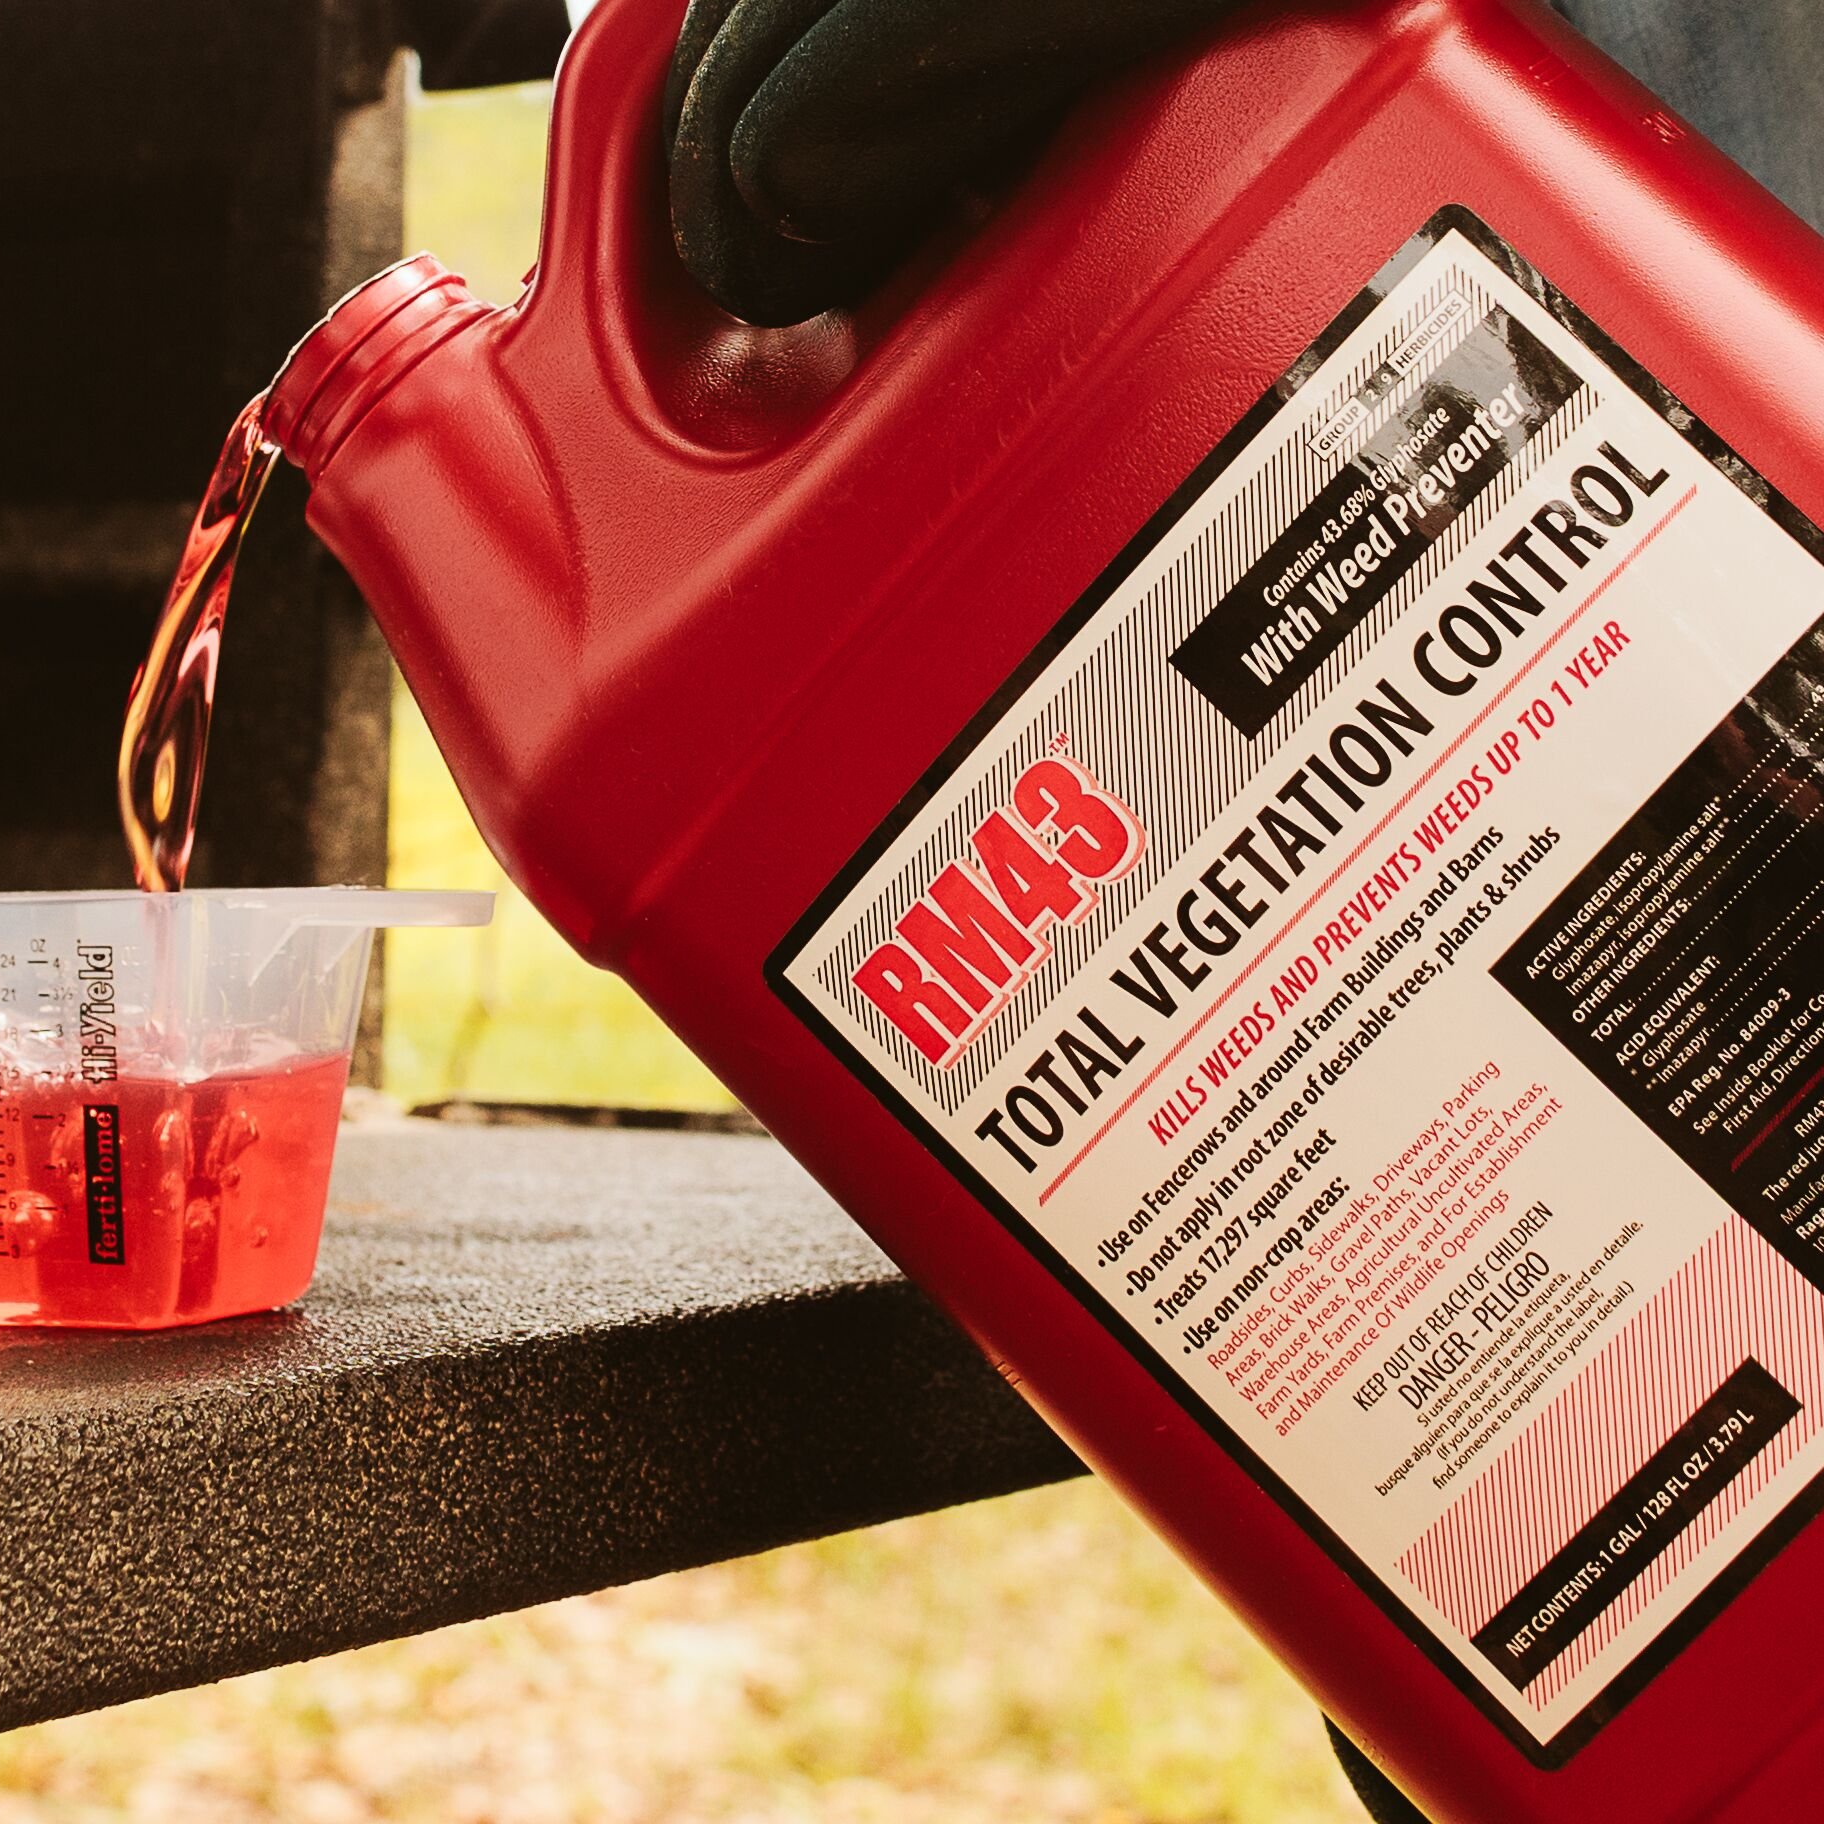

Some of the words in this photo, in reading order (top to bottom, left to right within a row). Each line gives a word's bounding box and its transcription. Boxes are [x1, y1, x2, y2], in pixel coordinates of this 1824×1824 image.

[1318, 405, 1358, 451] GROUP
[1394, 301, 1462, 369] HERBICIDES
[1239, 603, 1322, 686] With
[1304, 512, 1397, 616] Weed
[1382, 379, 1523, 537] Preventer
[1262, 538, 1326, 607] Contains
[1320, 482, 1376, 544] 43.68%
[1365, 406, 1451, 493] Glyphosate
[973, 1004, 1146, 1174] TOTAL
[1107, 676, 1435, 1019] VEGETATION
[1412, 439, 1670, 697] CONTROL
[1146, 1074, 1208, 1147] KILLS
[1197, 999, 1276, 1088] WEEDS
[1269, 954, 1319, 1017] AND
[1311, 841, 1422, 966] PREVENTS
[1411, 763, 1494, 854] WEEDS
[1484, 729, 1521, 775] UP
[1516, 698, 1555, 741] TO
[1549, 679, 1573, 706] 1
[1563, 619, 1631, 689] YEAR
[0, 957, 16, 968] 24
[1, 988, 16, 1001] 21
[30, 939, 46, 951] OZ
[1525, 930, 1570, 979] ACTIVE
[1562, 850, 1647, 937] INGREDIENTS:
[1614, 1031, 1647, 1066] ACID
[1641, 954, 1721, 1036] EQUIVALENT:
[5, 1109, 19, 1122] 12
[1096, 1229, 1134, 1263] Use
[1126, 1207, 1154, 1235] on
[1140, 1125, 1227, 1216] Fencerows
[1219, 1087, 1258, 1133] and
[1249, 1027, 1313, 1100] around
[1300, 990, 1353, 1041] Farm
[1340, 910, 1425, 997] Buildings
[1418, 870, 1458, 917] and
[1445, 825, 1504, 882] Barns
[1125, 1264, 1156, 1293] Do
[1148, 1234, 1183, 1272] not
[1173, 1191, 1223, 1244] apply
[1209, 1175, 1239, 1200] in
[1230, 1137, 1272, 1183] root
[1262, 1099, 1308, 1148] zone
[1301, 1072, 1325, 1105] of
[1317, 1004, 1397, 1086] desirable
[1386, 958, 1444, 1009] trees,
[1434, 899, 1492, 966] plants
[1481, 882, 1508, 906] &
[1500, 825, 1561, 891] shrubs
[1666, 1088, 1697, 1117] EPA
[1690, 1064, 1723, 1093] Reg.
[1716, 1042, 1744, 1065] No.
[1738, 986, 1791, 1042] 84009-3
[1691, 1109, 1719, 1135] See
[1712, 1073, 1752, 1113] Inside
[1746, 1027, 1796, 1077] Booklet
[1789, 1008, 1812, 1031] for
[1152, 1267, 1208, 1321] Treats
[1197, 1214, 1250, 1274] 17,297
[1245, 1165, 1304, 1228] square
[1292, 1127, 1337, 1172] feet
[1181, 1316, 1220, 1350] Use
[1213, 1294, 1240, 1323] on
[1230, 1225, 1305, 1303] non-crop
[1296, 1175, 1350, 1232] areas:
[1205, 1303, 1276, 1371] Roadsides,
[1268, 1261, 1315, 1303] Curbs,
[1306, 1192, 1381, 1263] Sidewalks,
[1371, 1118, 1449, 1192] Driveways,
[1441, 1060, 1501, 1118] Parking
[1224, 1347, 1267, 1388] Areas,
[1257, 1312, 1296, 1349] Brick
[1286, 1273, 1336, 1316] Walks,
[1329, 1222, 1376, 1273] Gravel
[1368, 1187, 1416, 1231] Paths,
[1407, 1136, 1461, 1186] Vacant
[1452, 1105, 1494, 1140] Lots,
[1237, 1330, 1311, 1402] Warehouse
[1305, 1292, 1351, 1335] Areas,
[1344, 1207, 1422, 1294] Agricultural
[1415, 1119, 1505, 1214] Uncultivated
[1500, 1082, 1548, 1127] Areas,
[1254, 1384, 1293, 1421] Farm
[1284, 1349, 1330, 1387] Yards,
[1320, 1312, 1361, 1350] Farm
[1353, 1251, 1422, 1316] Premises,
[1416, 1216, 1446, 1253] and
[1439, 1194, 1468, 1224] For
[1462, 1097, 1563, 1199] Establishment
[1351, 1371, 1388, 1412] KEEP
[1382, 1342, 1416, 1379] OUT
[1407, 1324, 1432, 1353] OF
[1423, 1282, 1475, 1336] REACH
[1465, 1263, 1490, 1292] OF
[1484, 1199, 1553, 1272] CHILDREN
[1396, 1330, 1476, 1410] DANGER
[1470, 1250, 1550, 1333] PELIGRO
[1504, 1623, 1536, 1657] NET
[1530, 1559, 1606, 1632] CONTENTS:
[1598, 1549, 1614, 1564] 1
[1608, 1522, 1642, 1555] GAL
[1641, 1489, 1672, 1520] 128
[1663, 1475, 1690, 1498] FL
[1681, 1451, 1710, 1479] OZ
[1707, 1416, 1743, 1453] 3.79
[1735, 1408, 1754, 1424] L
